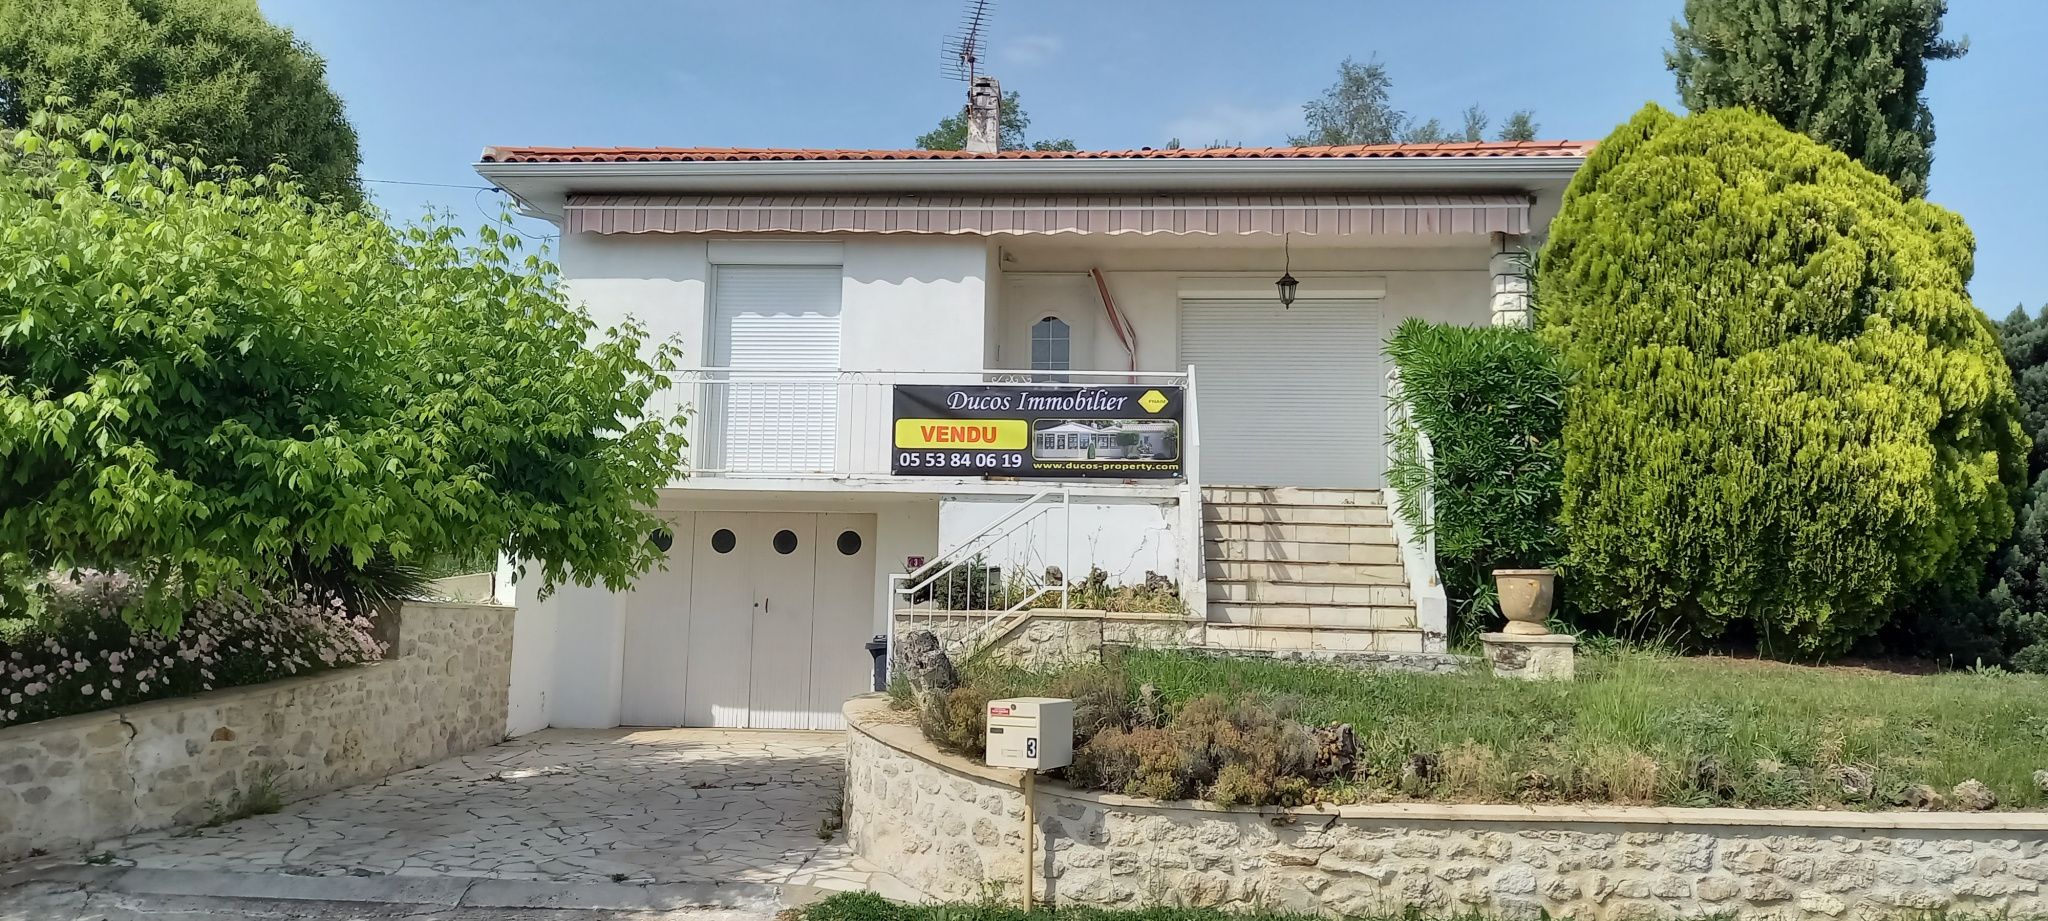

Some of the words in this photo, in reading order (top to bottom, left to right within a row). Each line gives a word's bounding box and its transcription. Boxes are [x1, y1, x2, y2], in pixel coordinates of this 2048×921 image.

[947, 391, 1010, 410] Ducos
[1016, 392, 1127, 411] Immobilier
[921, 425, 997, 443] VENDU
[899, 452, 919, 467] 05
[925, 452, 945, 467] 53
[950, 453, 970, 468] 84
[975, 453, 996, 468] 06
[1002, 454, 1021, 468] 19
[1033, 462, 1179, 471] www.ducos-property.com
[1027, 739, 1036, 757] 3
